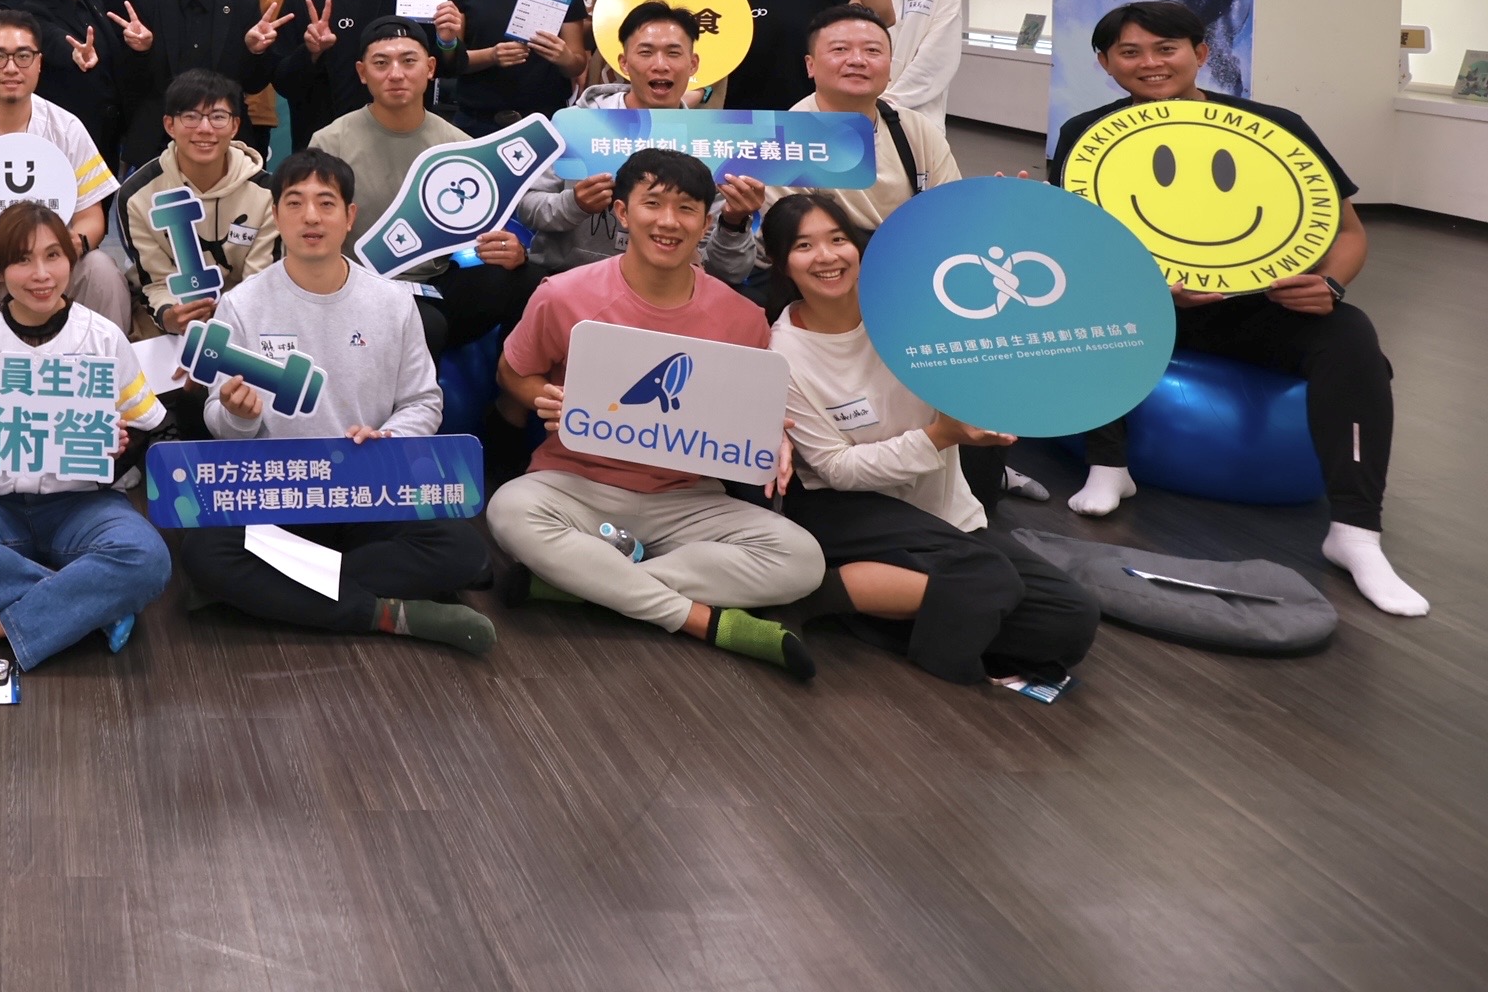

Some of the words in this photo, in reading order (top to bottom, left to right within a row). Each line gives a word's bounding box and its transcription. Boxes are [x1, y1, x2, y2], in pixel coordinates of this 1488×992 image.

[1076, 107, 1170, 164] YAKINIKU
[1204, 108, 1275, 139] UMAI
[905, 322, 1138, 358] 中華民國運動員生涯規劃發展協會
[910, 359, 947, 369] Athletes
[950, 355, 979, 366] Based
[981, 351, 1013, 362] Career
[1017, 345, 1081, 360] Development
[1085, 338, 1144, 352] Association
[565, 408, 774, 470] GoodWhale
[196, 459, 332, 484] 用方法與策略
[213, 483, 465, 512] 陪伴運動員度過人生難關
